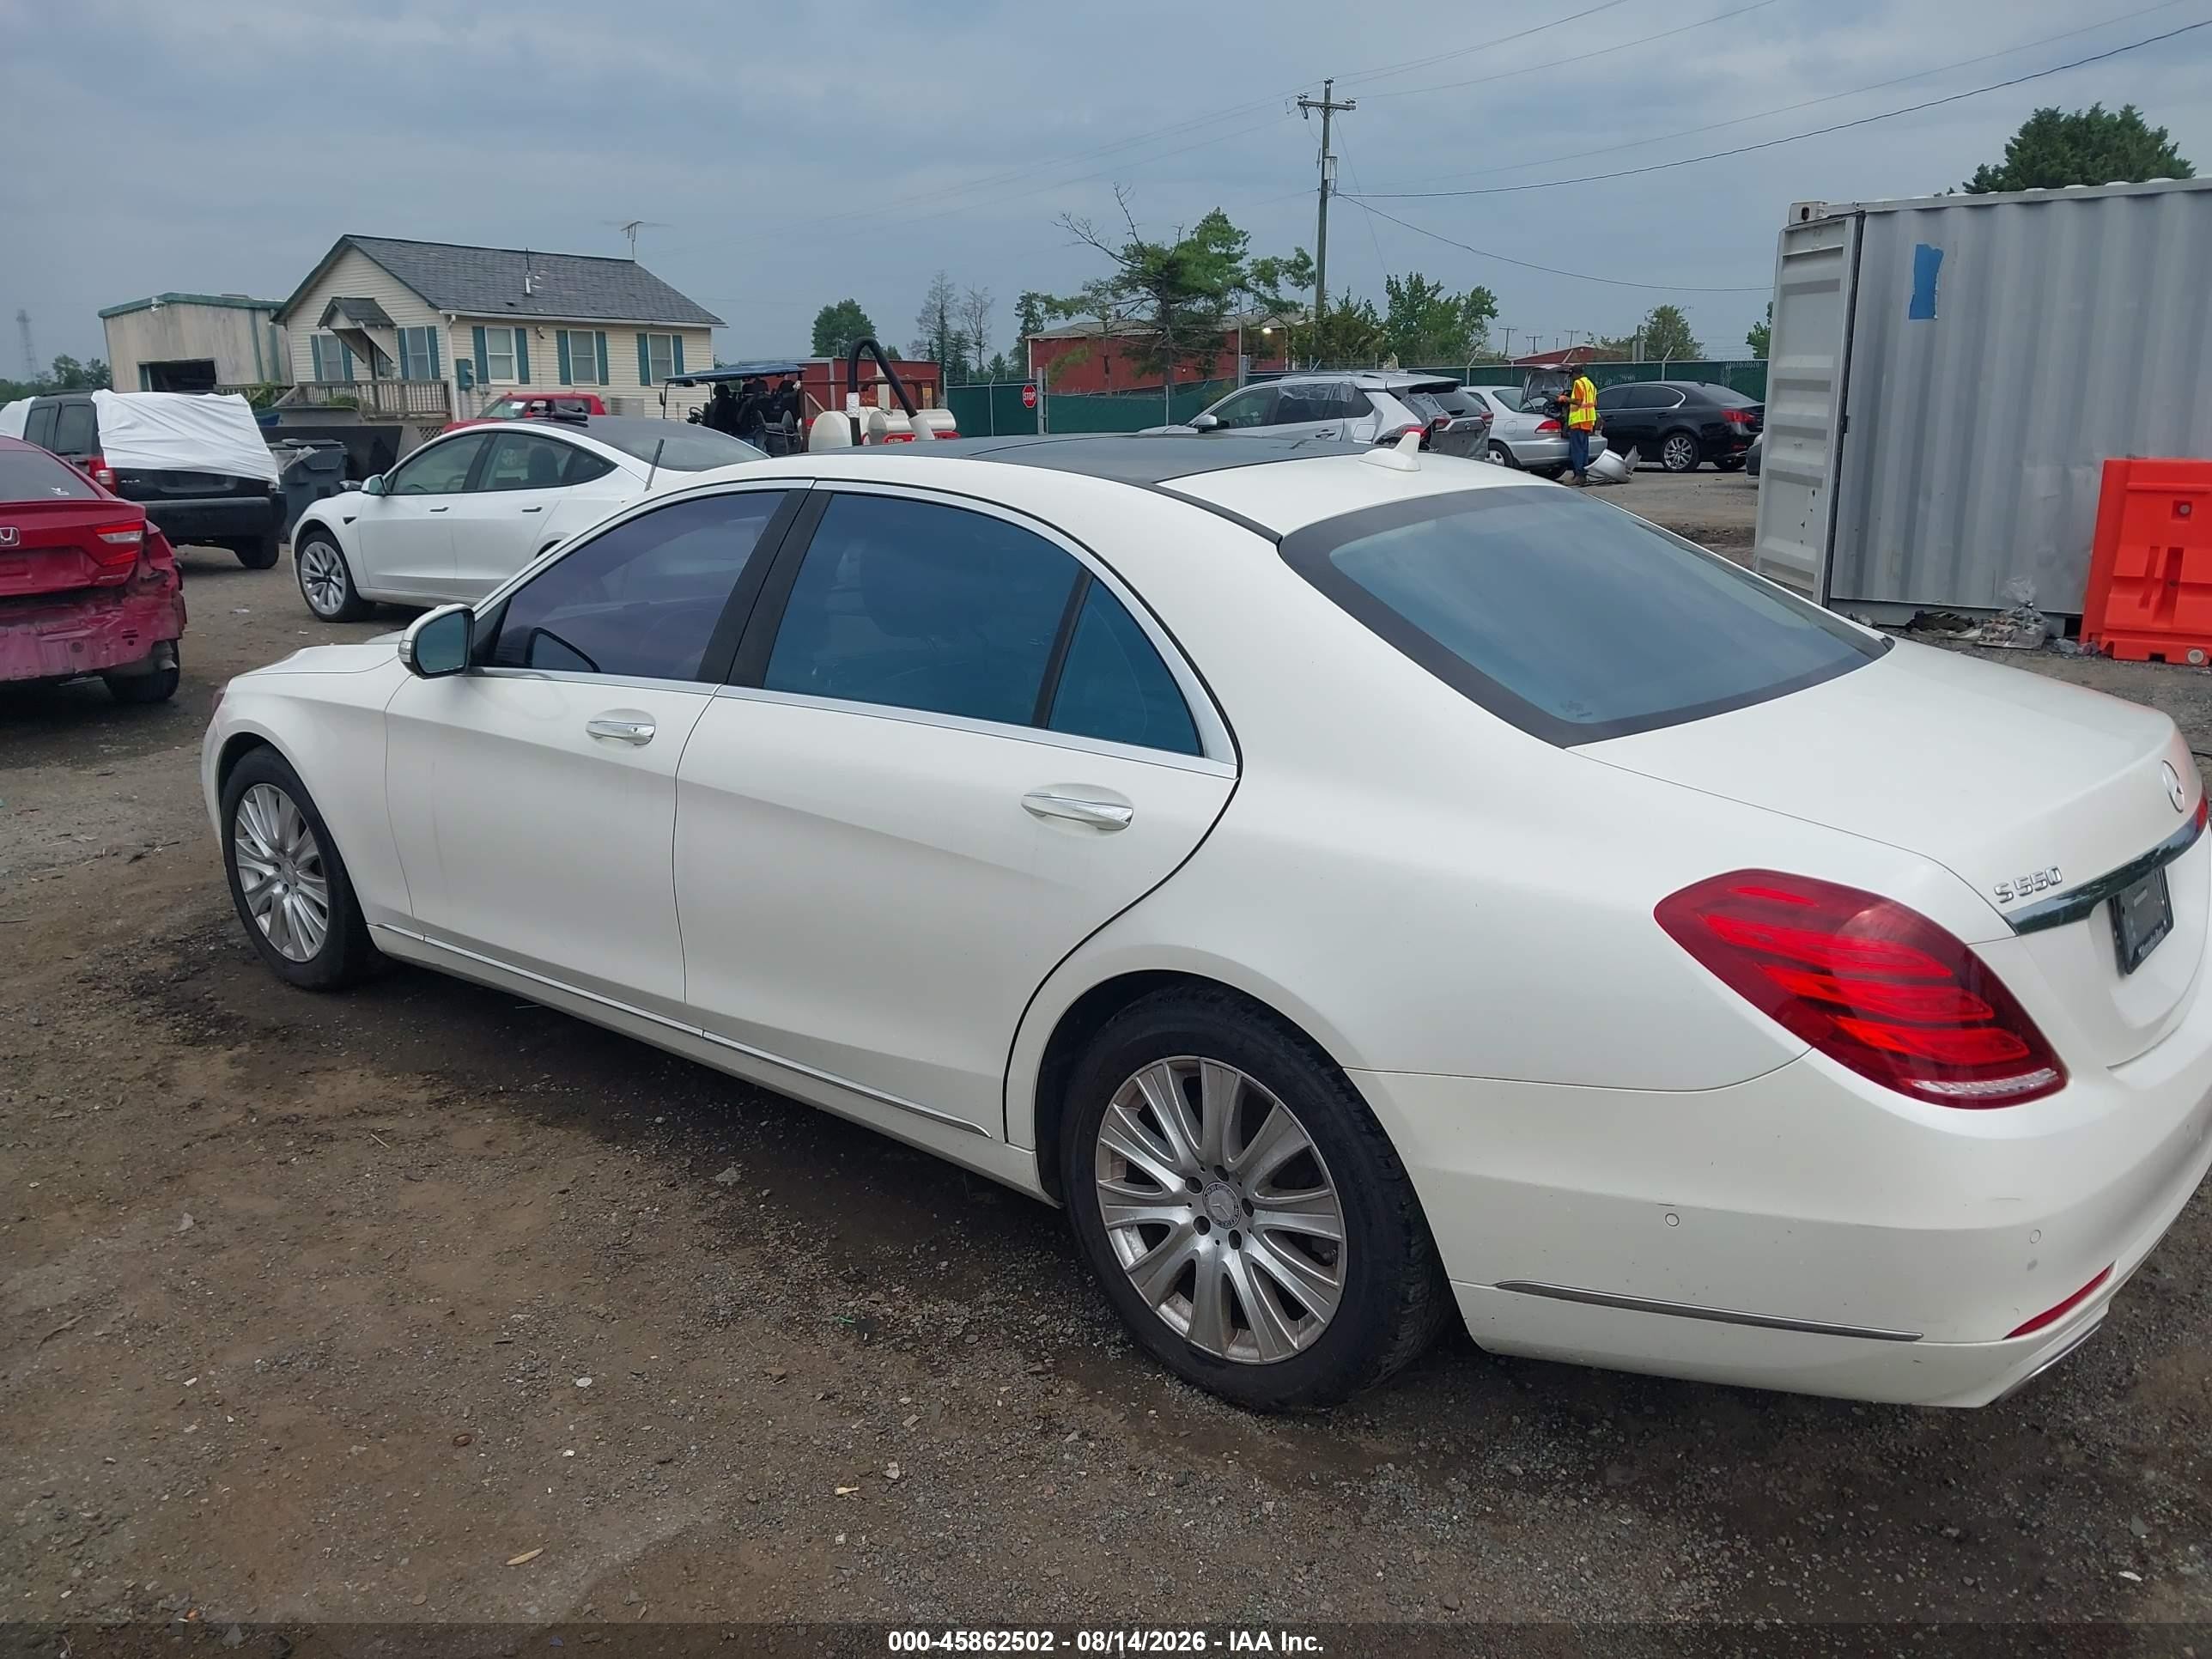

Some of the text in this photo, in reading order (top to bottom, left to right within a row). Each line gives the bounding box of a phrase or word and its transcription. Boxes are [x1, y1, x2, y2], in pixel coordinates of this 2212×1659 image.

[1024, 392, 1036, 401] STOP
[1994, 866, 2063, 903] S 550
